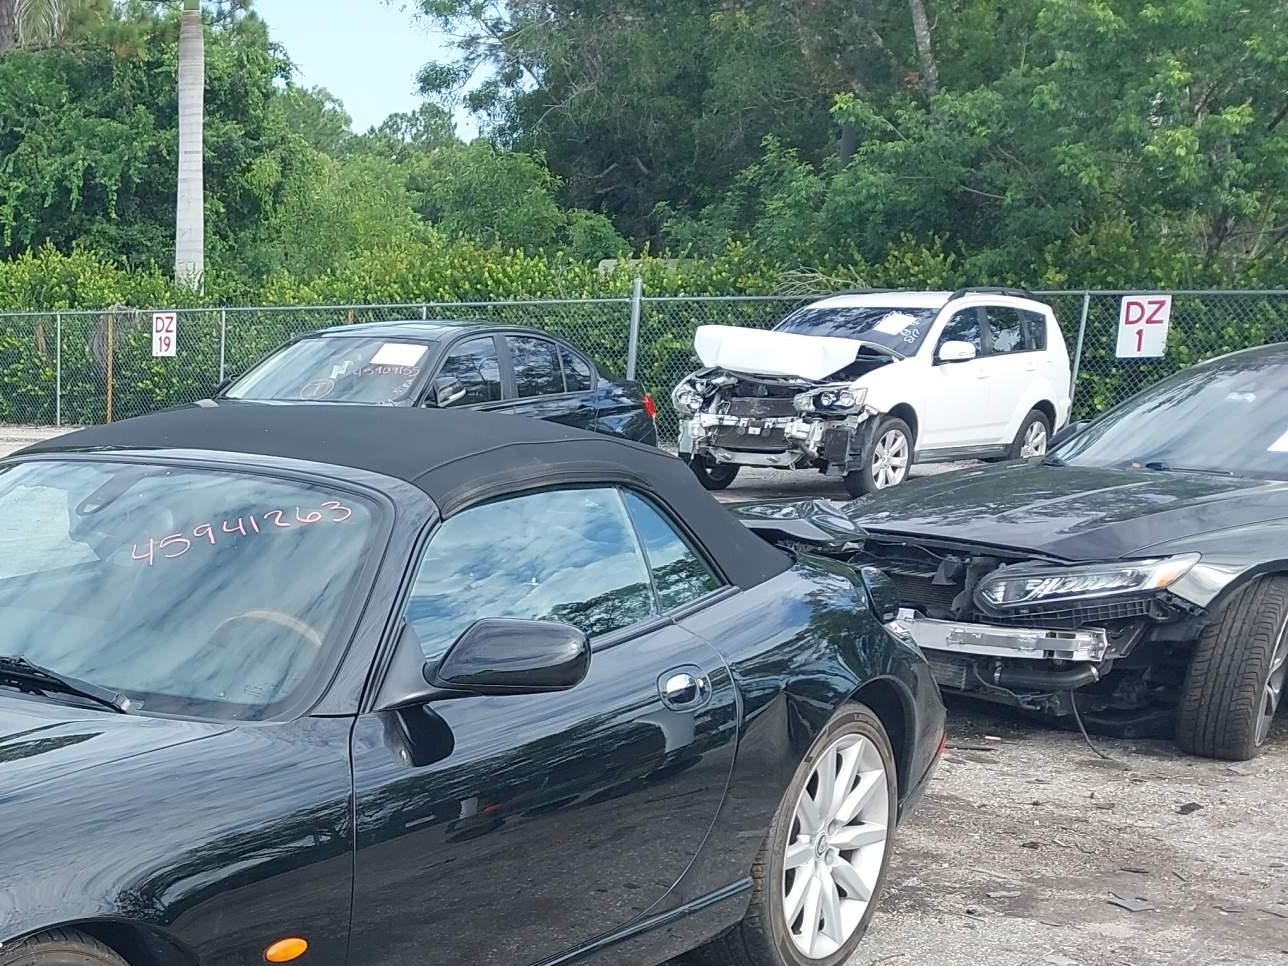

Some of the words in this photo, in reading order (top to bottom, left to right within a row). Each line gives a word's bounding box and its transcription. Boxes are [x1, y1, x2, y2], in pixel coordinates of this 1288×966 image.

[1124, 299, 1167, 325] DZ
[155, 316, 174, 333] DZ
[158, 335, 171, 352] 19
[1135, 328, 1144, 352] 1
[131, 500, 352, 566] 45941263
